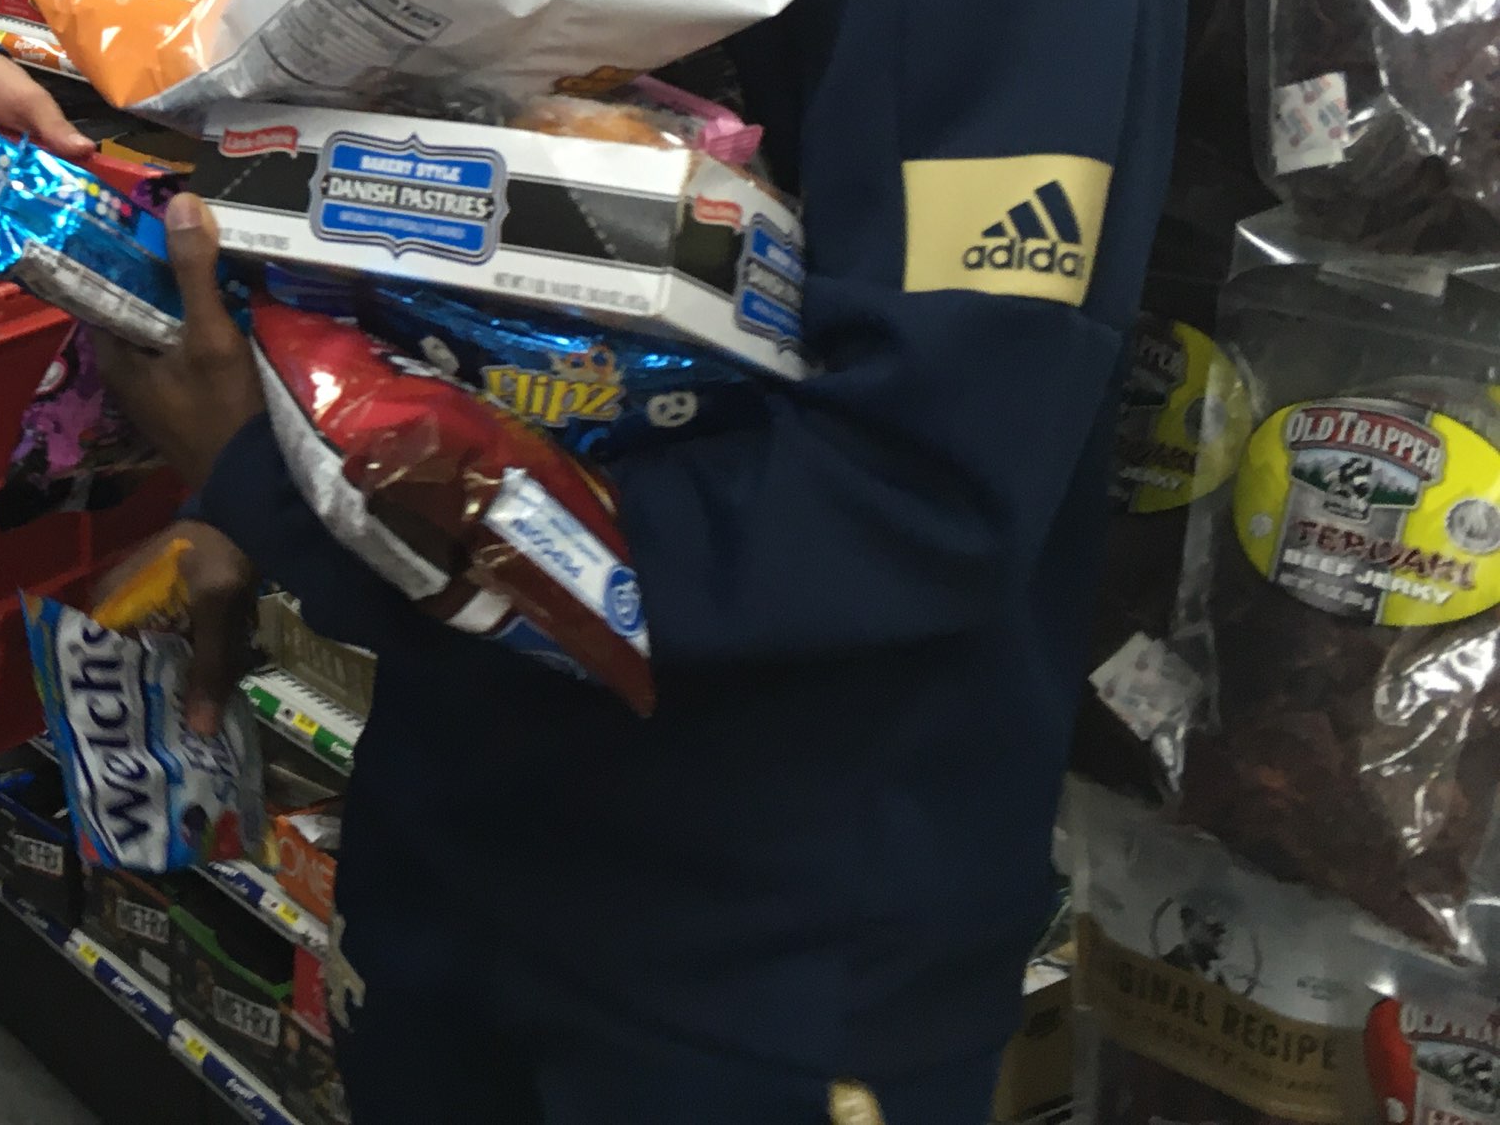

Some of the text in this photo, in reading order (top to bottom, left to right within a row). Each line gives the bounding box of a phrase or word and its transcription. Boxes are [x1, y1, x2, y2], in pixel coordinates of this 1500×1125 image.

[361, 154, 462, 183] BAKERY STYLE
[328, 176, 489, 219] DANISH PASTRIES
[962, 237, 1086, 281] adida
[1286, 410, 1443, 476] OLD TRAPPER
